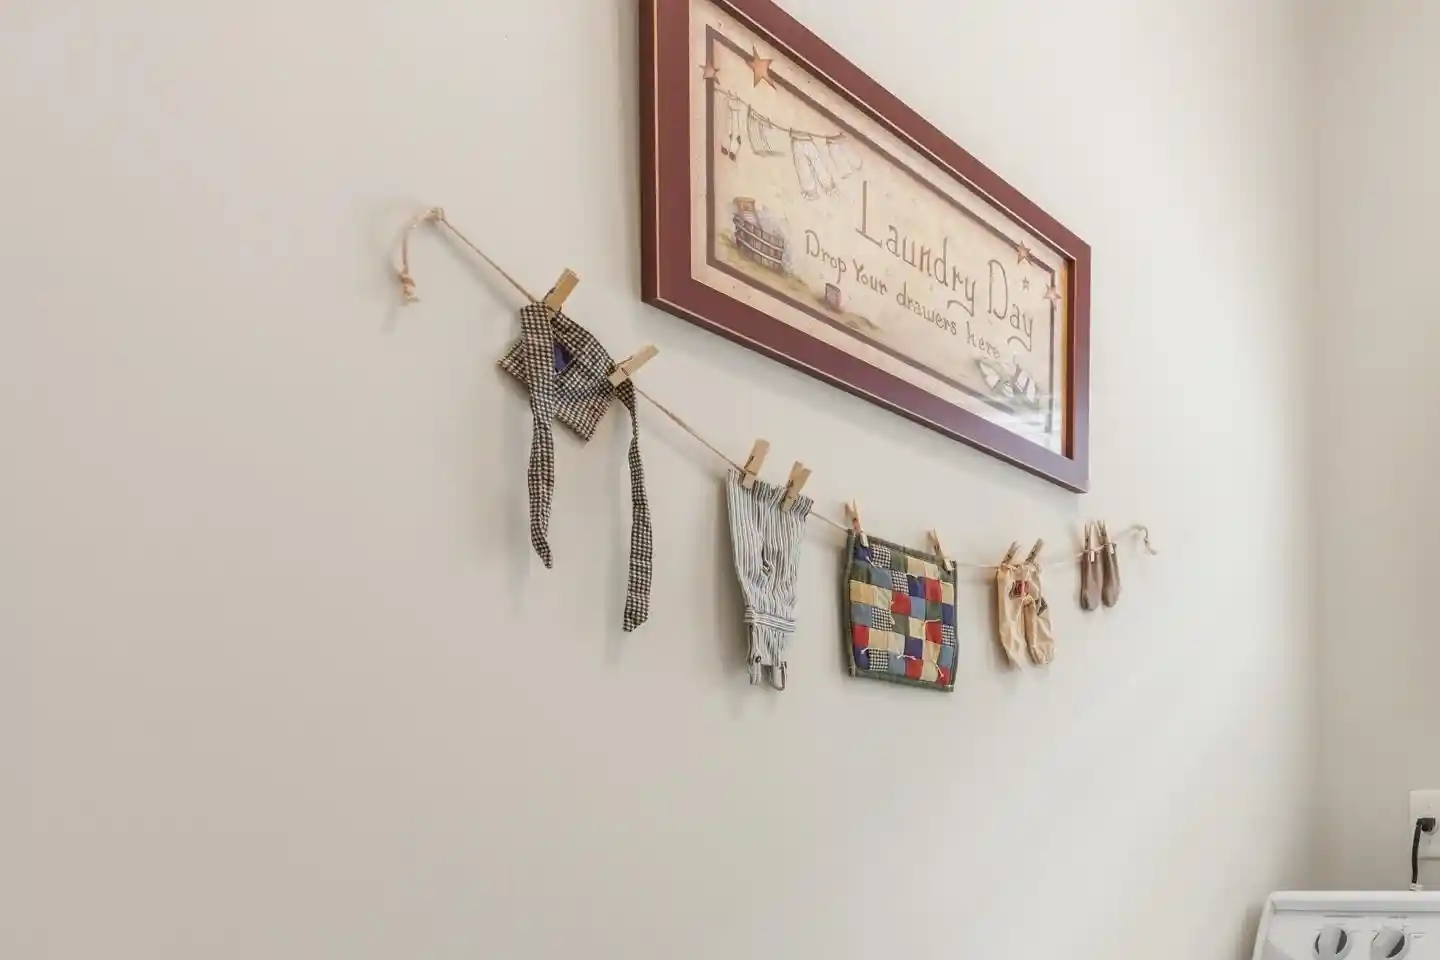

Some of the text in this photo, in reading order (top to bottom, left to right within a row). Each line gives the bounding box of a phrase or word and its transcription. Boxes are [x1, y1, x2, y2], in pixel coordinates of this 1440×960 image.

[804, 229, 1001, 359] Drop Your drawers here
[855, 180, 1034, 353] Laundry Day
